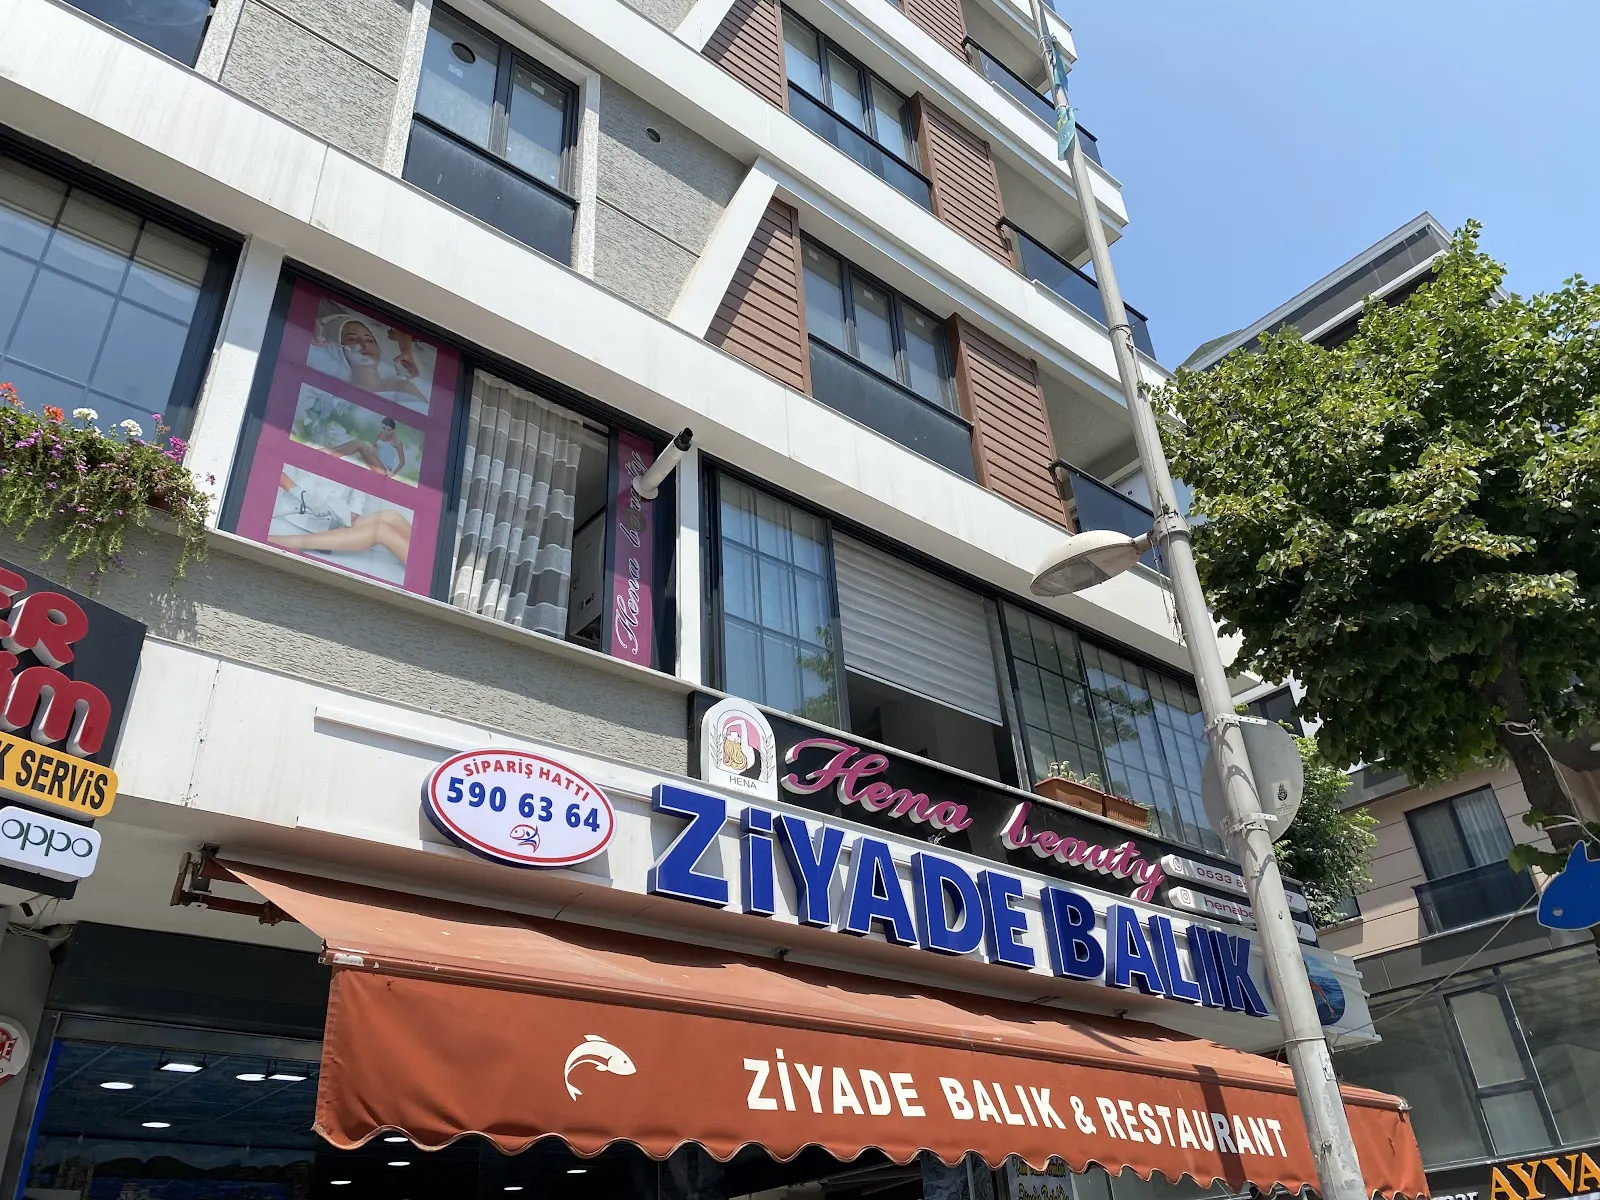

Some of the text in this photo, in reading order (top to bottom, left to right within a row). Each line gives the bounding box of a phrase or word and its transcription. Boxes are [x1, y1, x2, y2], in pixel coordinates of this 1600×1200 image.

[615, 557, 641, 655] Hena
[446, 776, 600, 832] 590 63 64
[463, 759, 590, 802] SİPARİŞ HATTI
[729, 775, 757, 790] HENA
[1, 818, 93, 857] oppo
[781, 738, 1166, 903] Hena beauty
[1196, 867, 1232, 884] 0533
[1040, 886, 1269, 1017] BALIK
[743, 1048, 1288, 1158] ZİYADE BALIK & RESTAURANT
[1490, 1152, 1600, 1200] AYVA
